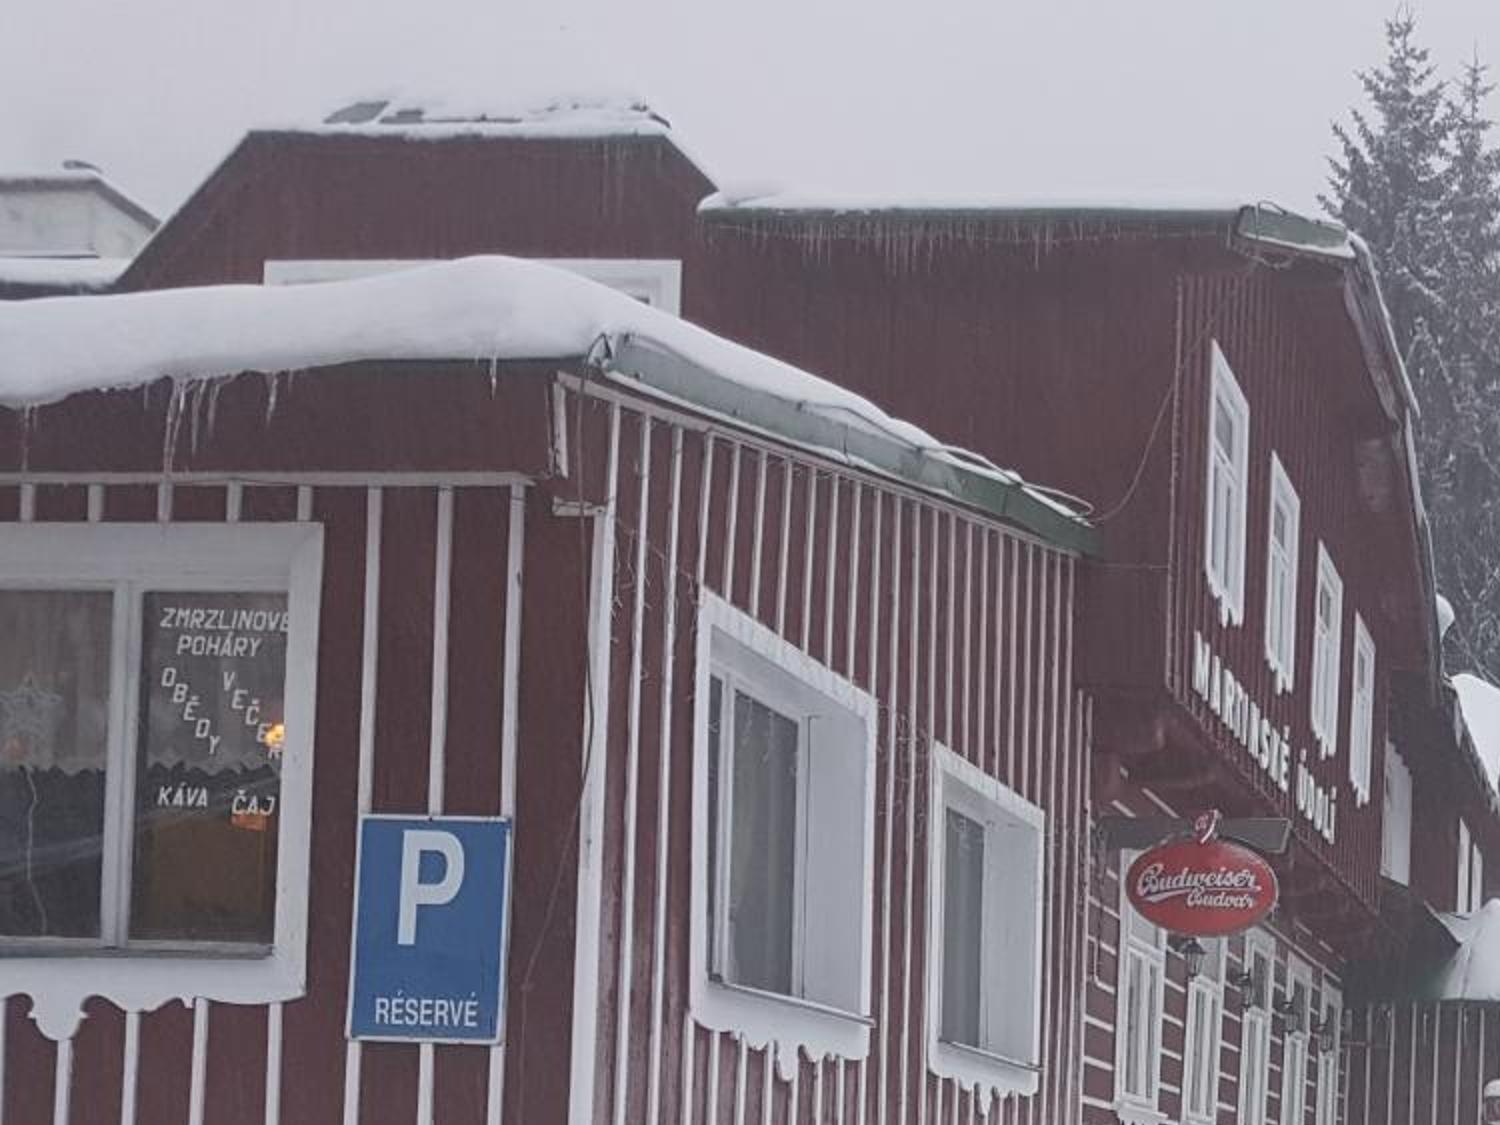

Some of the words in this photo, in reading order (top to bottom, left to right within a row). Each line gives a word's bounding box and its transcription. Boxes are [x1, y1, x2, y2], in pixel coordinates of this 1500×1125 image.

[176, 631, 262, 657] POHÁRY
[161, 667, 221, 756] OBĚDY
[1192, 630, 1291, 793] MARTINSKÉ
[157, 782, 208, 807] KÁVA
[231, 789, 276, 815] ČAJ
[397, 829, 465, 945] P
[1136, 863, 1261, 899] Budweiser
[375, 989, 479, 1028] RÉSERVÉ
